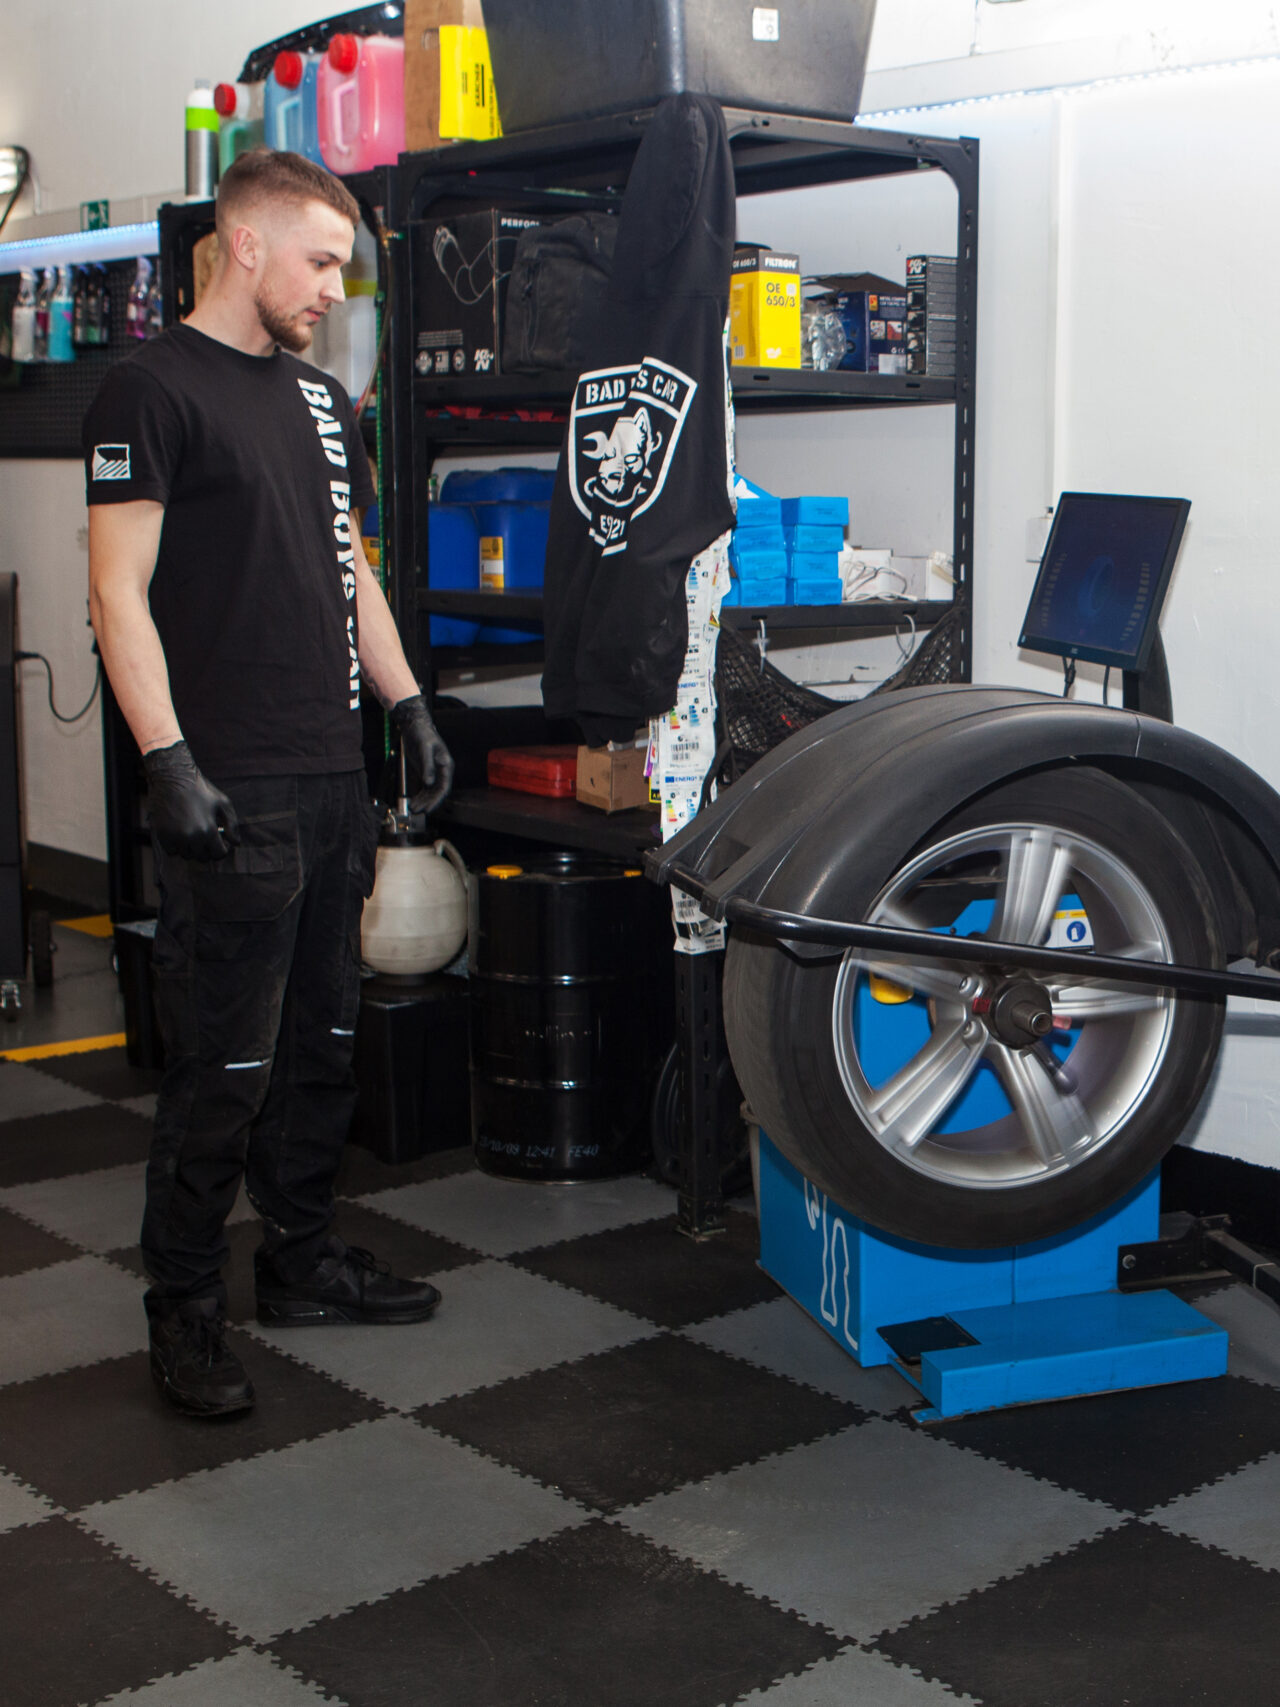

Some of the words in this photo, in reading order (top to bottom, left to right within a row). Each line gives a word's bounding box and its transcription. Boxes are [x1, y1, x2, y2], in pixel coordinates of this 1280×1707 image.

[500, 217, 540, 229] PERFO
[766, 282, 781, 294] OE
[766, 295, 796, 308] 650/3
[585, 377, 626, 405] BAD
[297, 377, 348, 469] BAD
